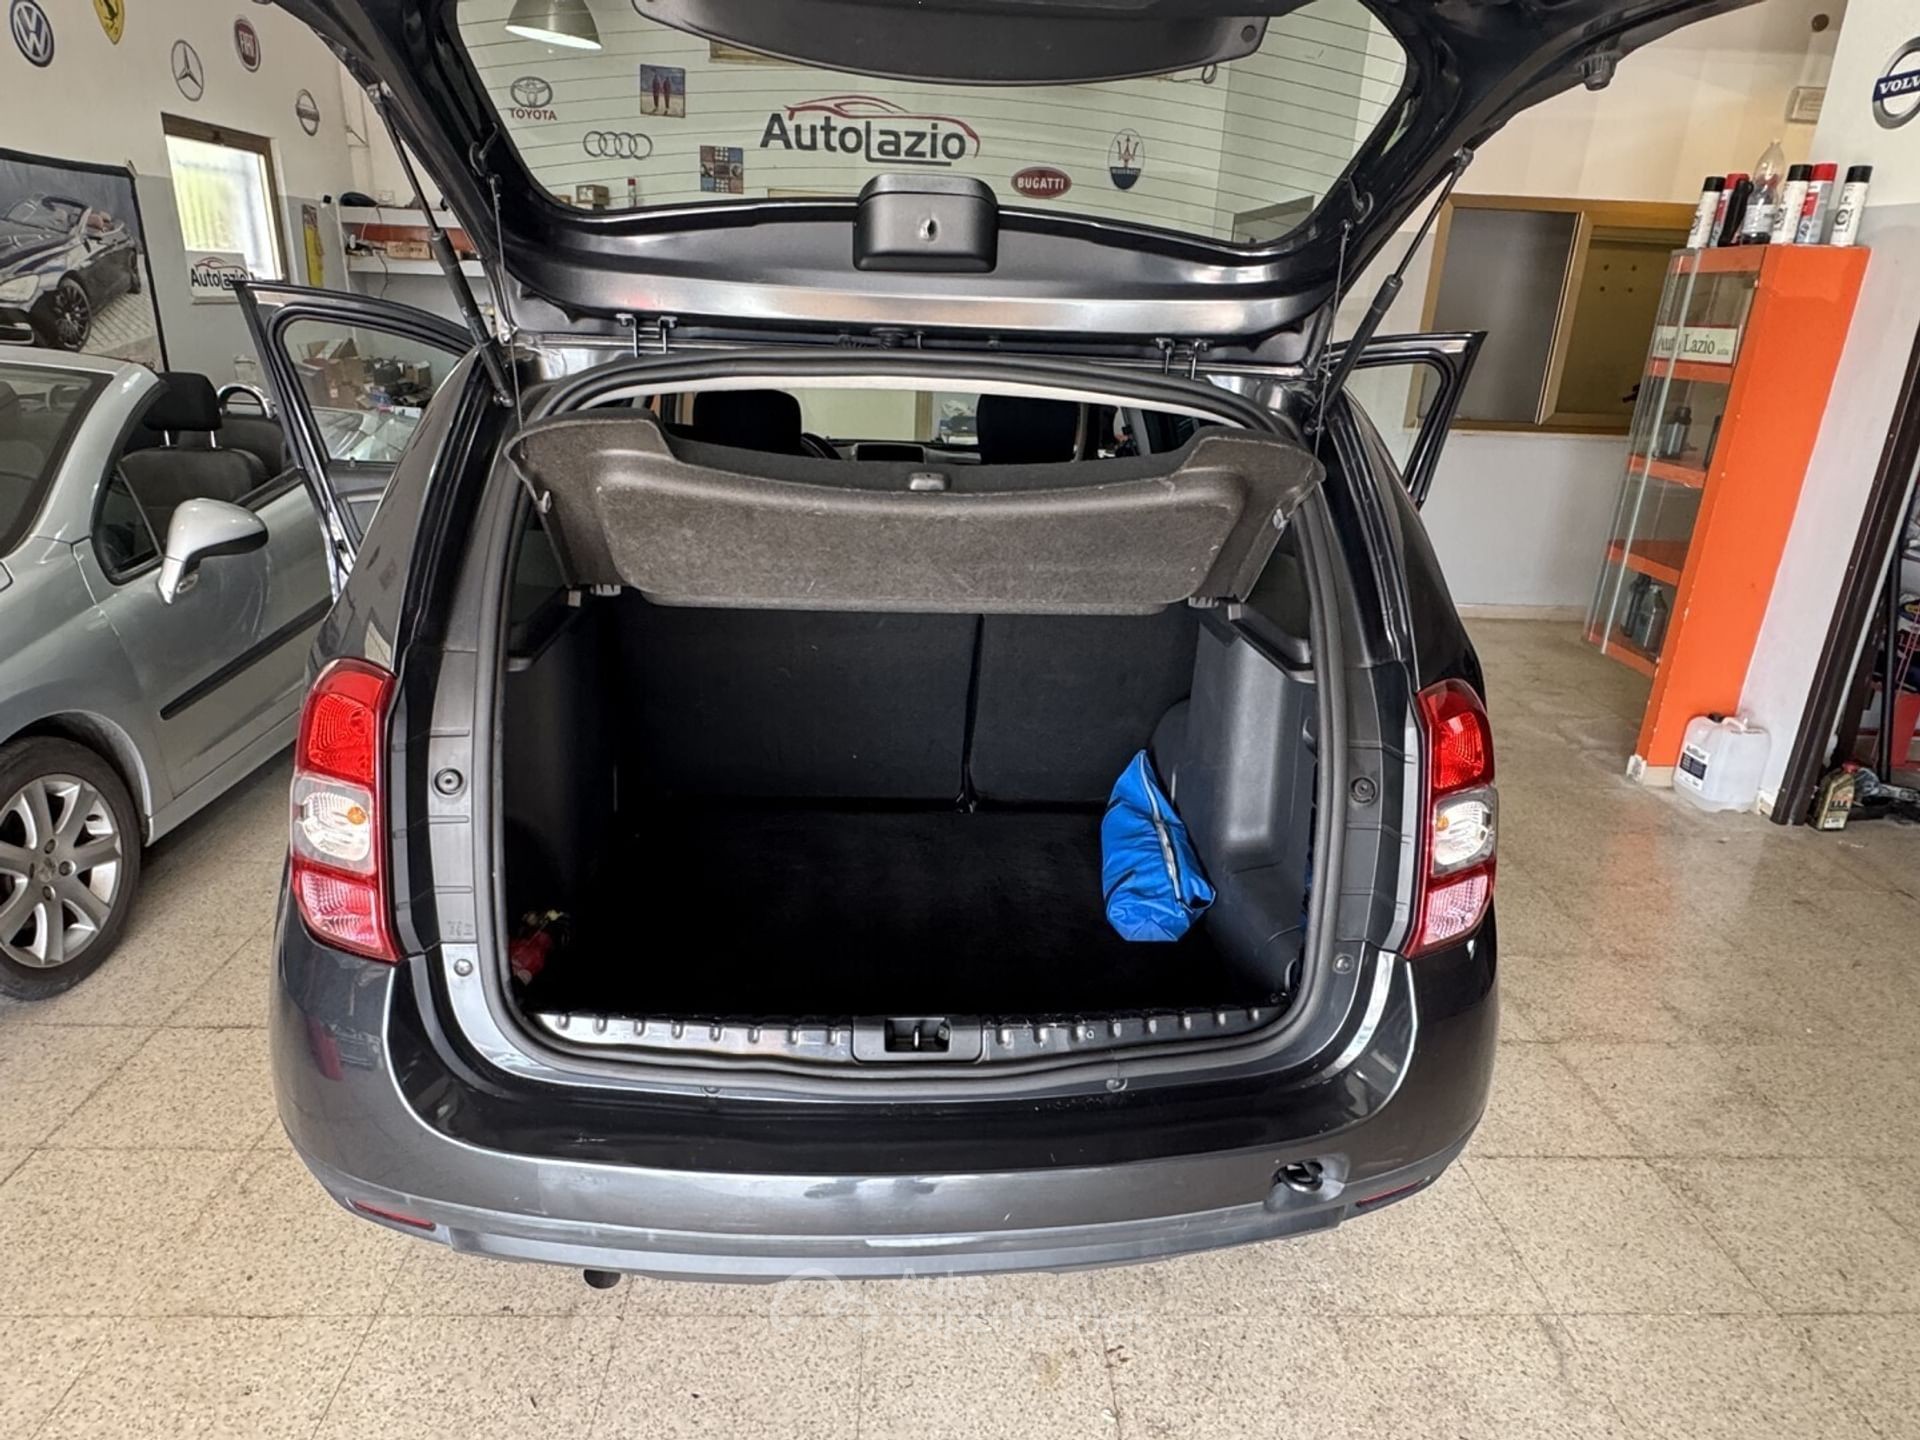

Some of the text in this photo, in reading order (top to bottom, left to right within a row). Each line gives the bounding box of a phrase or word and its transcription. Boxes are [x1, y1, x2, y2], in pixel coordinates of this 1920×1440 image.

[510, 107, 557, 121] TOYOTA
[1017, 177, 1064, 190] BUGATTI
[1683, 333, 1715, 355] Lazio
